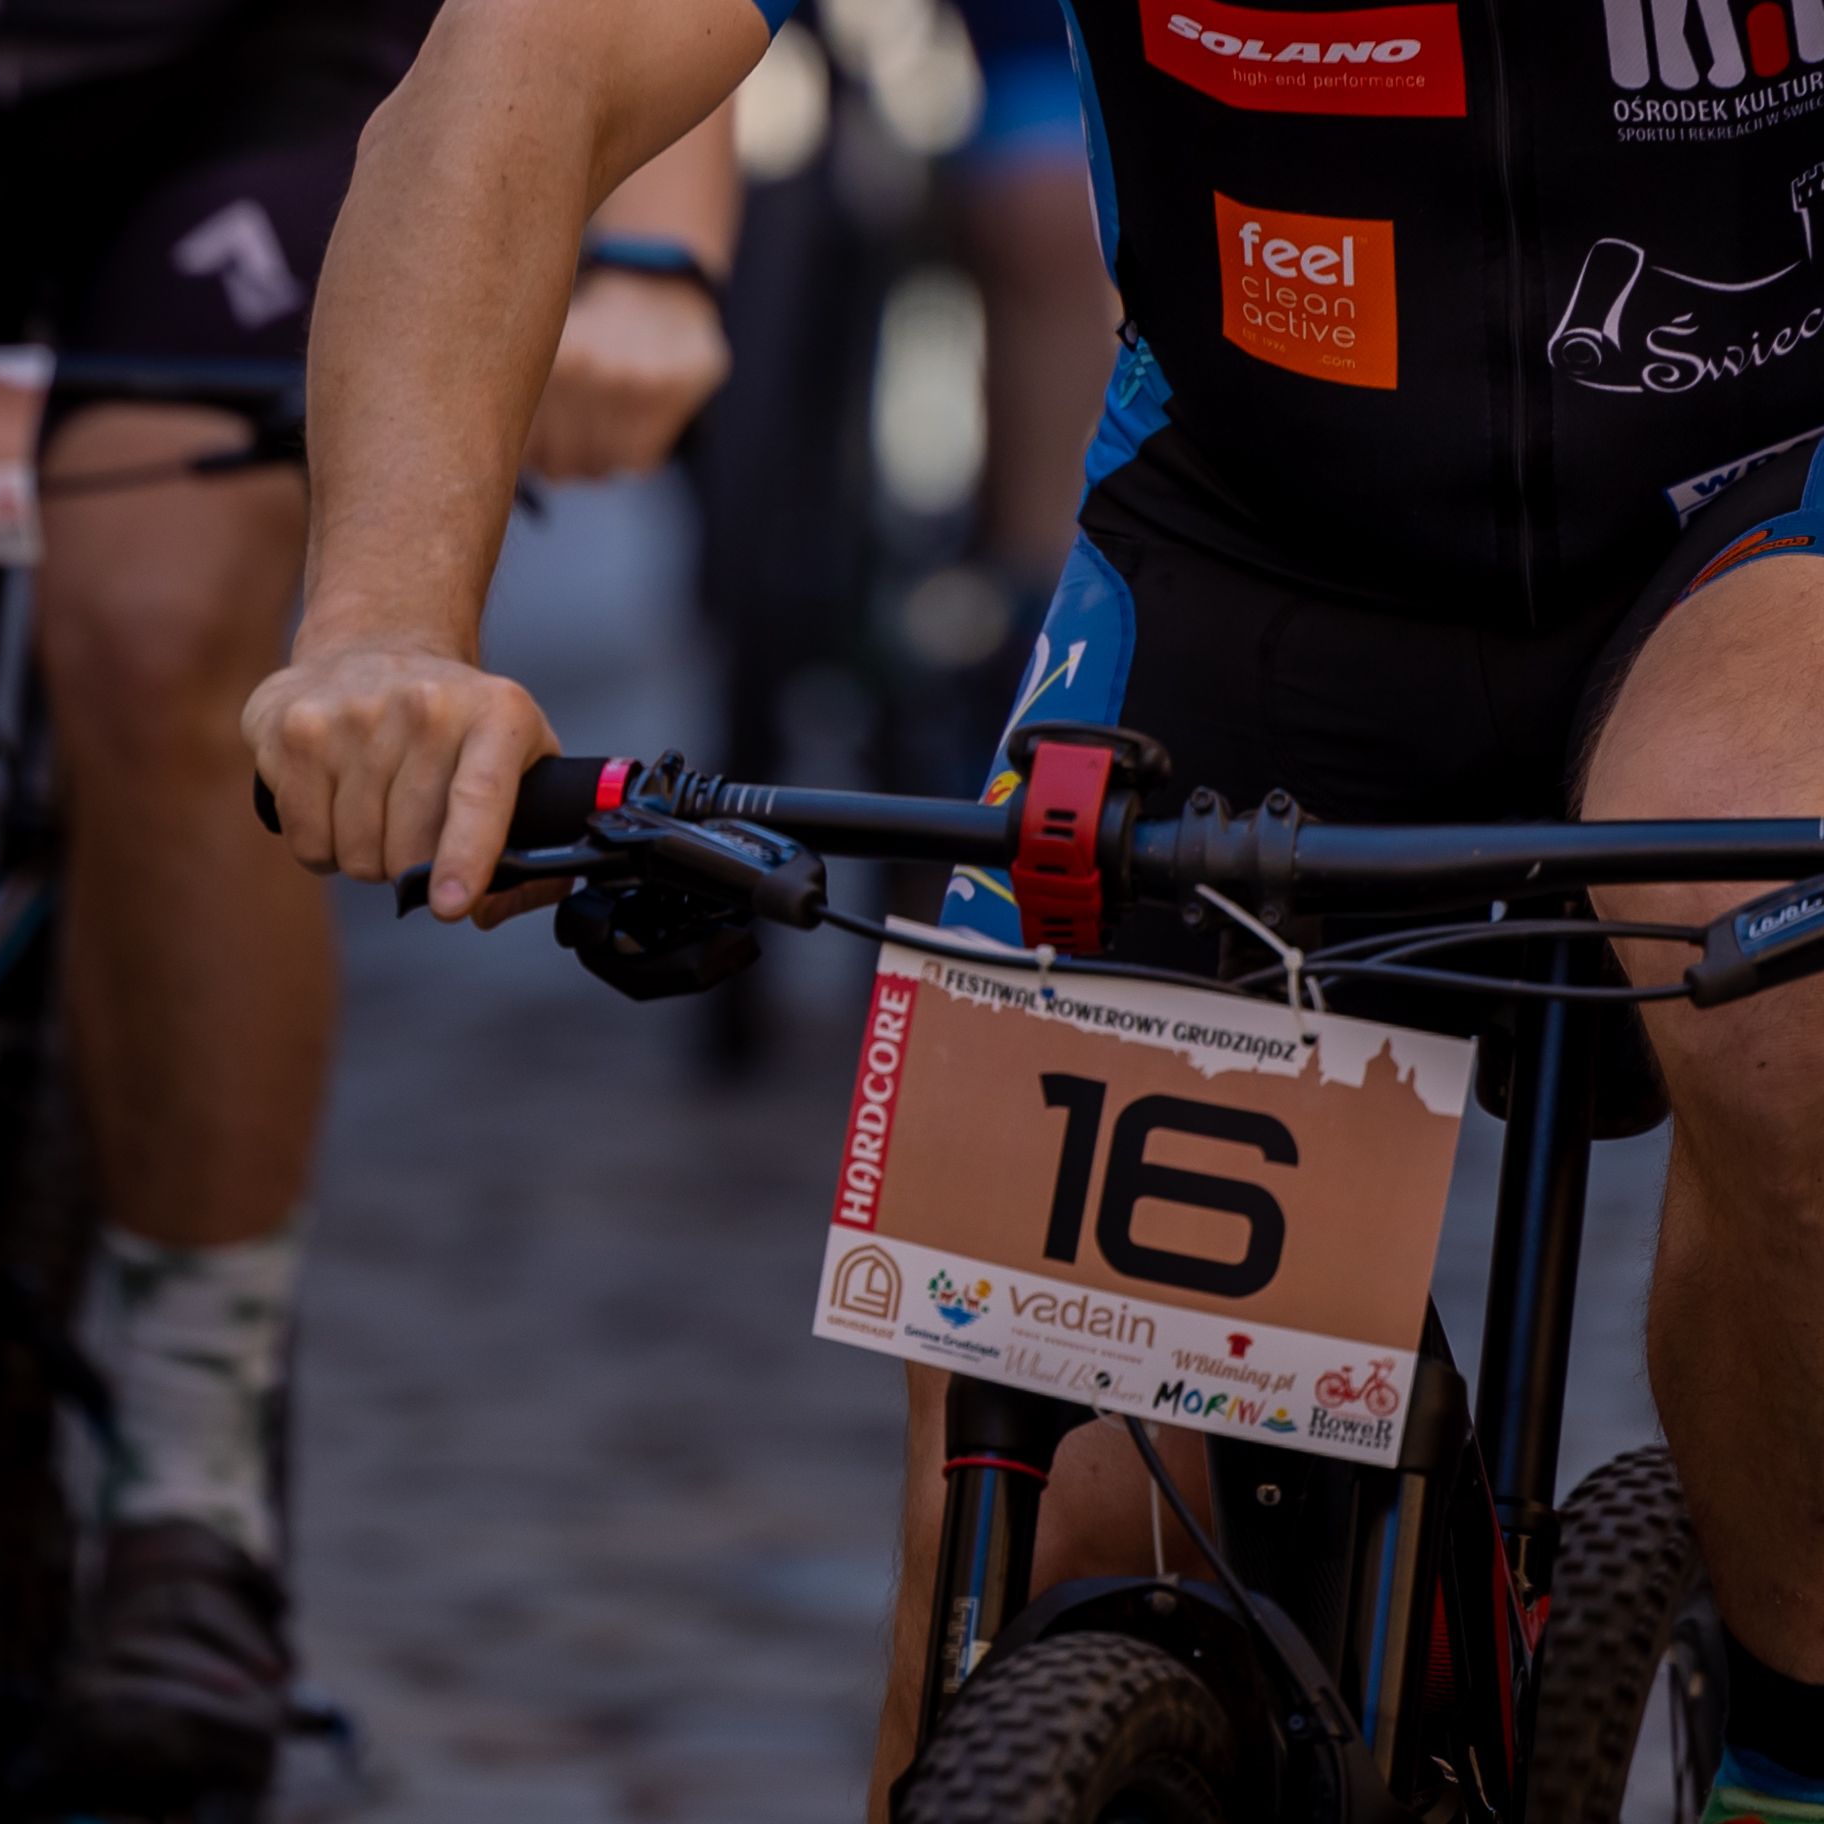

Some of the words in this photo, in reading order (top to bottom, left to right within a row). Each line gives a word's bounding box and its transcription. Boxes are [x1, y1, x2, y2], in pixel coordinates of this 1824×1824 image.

[1167, 13, 1422, 64] SOLANO
[1232, 67, 1306, 88] high-end
[1313, 71, 1426, 90] performance
[1613, 95, 1728, 123] OŚRODEK
[1617, 127, 1676, 143] SPORTU
[1766, 112, 1780, 127] W
[1238, 221, 1355, 288] feel
[1241, 275, 1356, 320] clean
[1242, 302, 1356, 349] active
[945, 968, 1040, 1011] FESTIWAL
[1046, 996, 1171, 1039] ROWEROWY
[839, 984, 913, 1224] HARDCORE
[1039, 1072, 1298, 1298] 16
[1009, 1284, 1156, 1350] vadain
